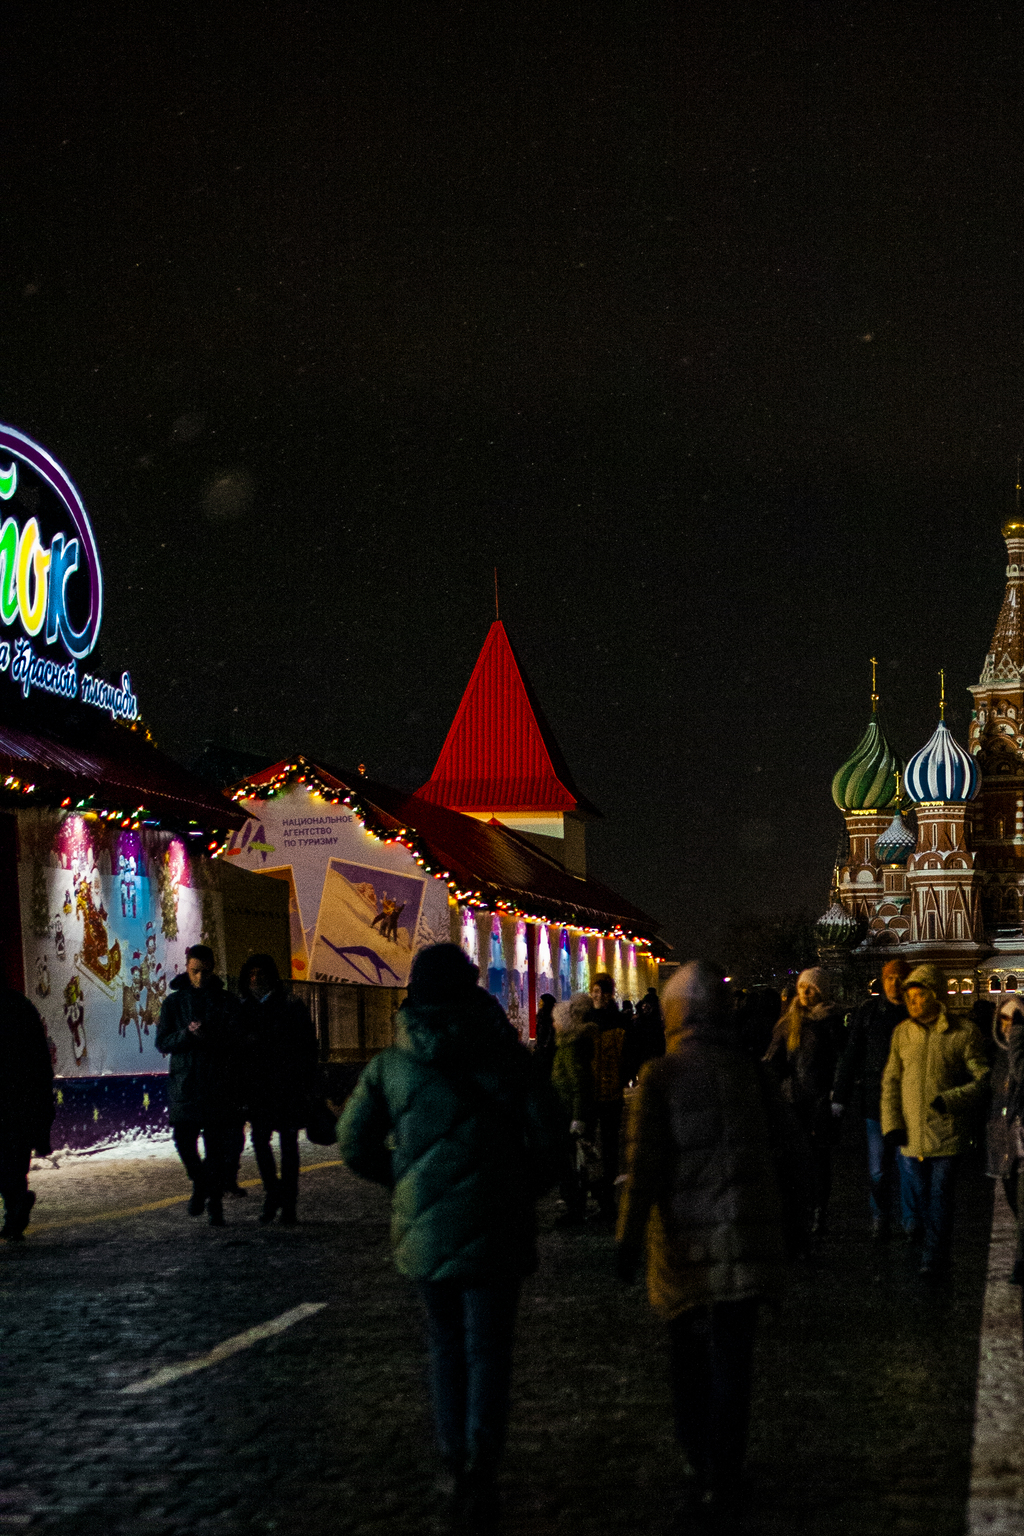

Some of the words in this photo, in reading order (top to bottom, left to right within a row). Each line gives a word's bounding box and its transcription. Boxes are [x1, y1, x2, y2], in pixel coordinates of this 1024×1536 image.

[12, 637, 77, 698] Красной
[81, 671, 137, 720] площади
[282, 815, 353, 828] НАЦИОНАЛЬНОЕ
[283, 827, 333, 838] АГЕНТСТВО
[284, 840, 298, 848] ПО
[298, 837, 339, 847] ТУРИЗМУ
